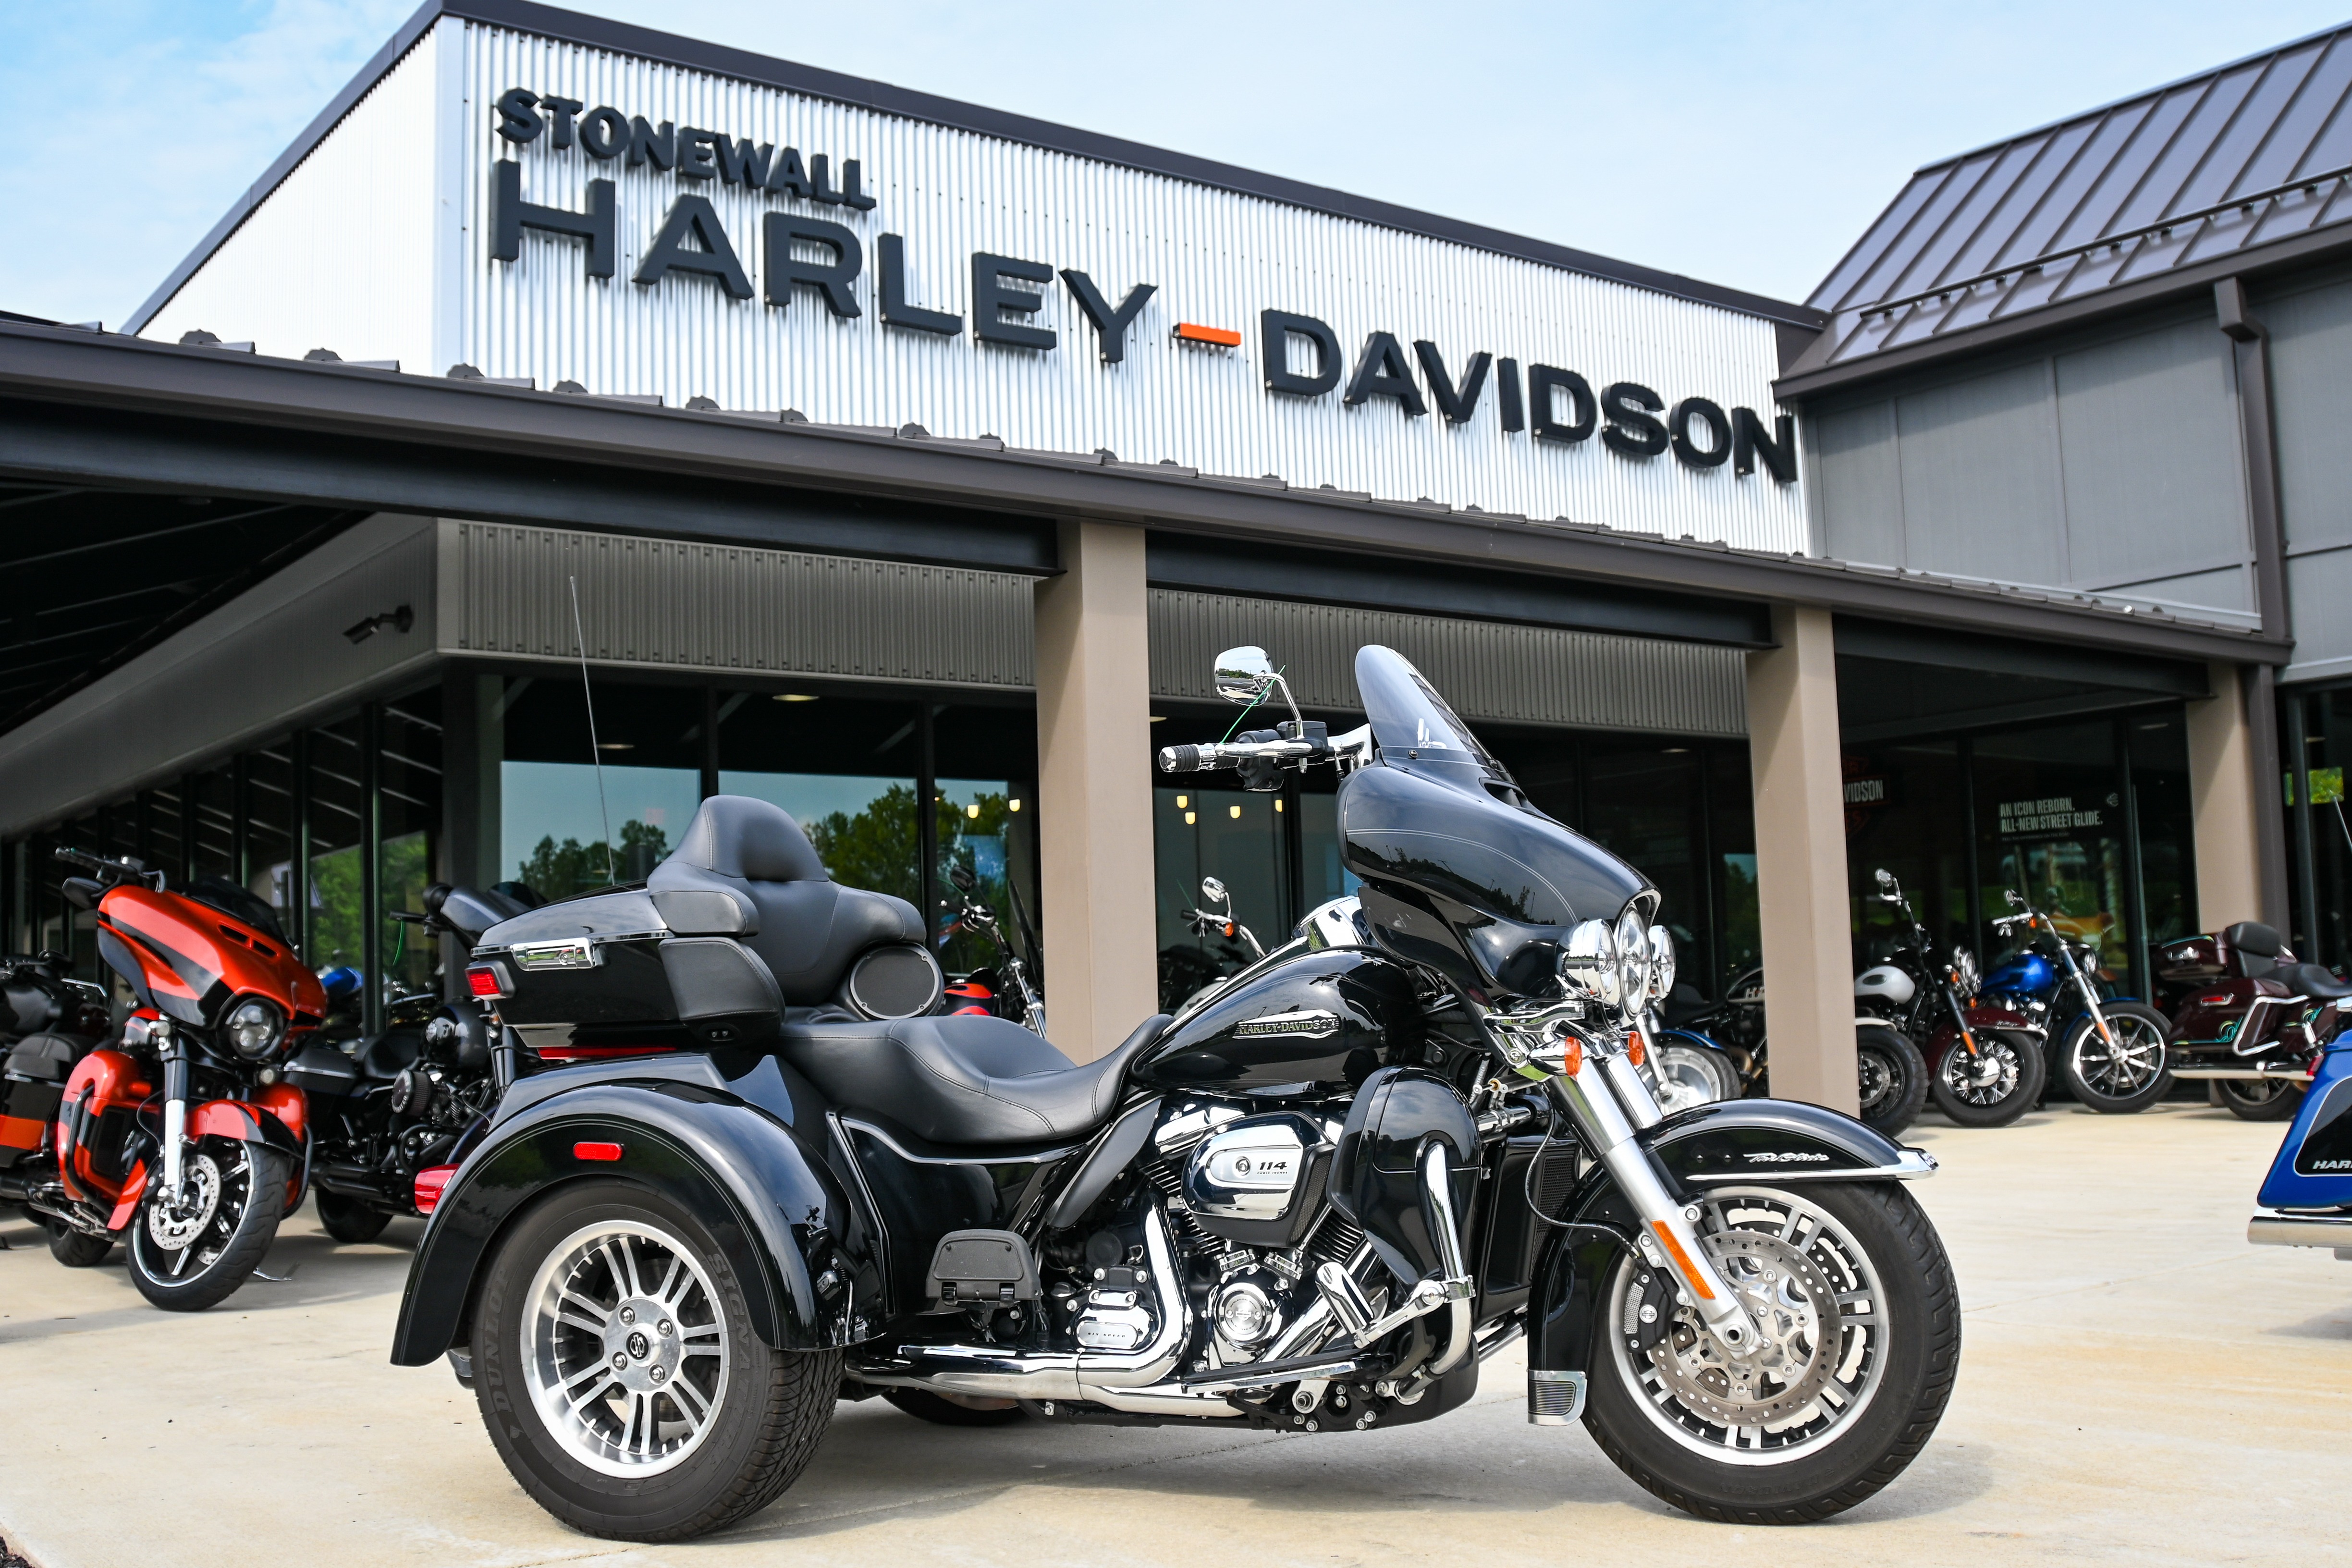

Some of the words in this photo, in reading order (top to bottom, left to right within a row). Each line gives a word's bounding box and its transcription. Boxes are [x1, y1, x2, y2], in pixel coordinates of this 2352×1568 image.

[494, 87, 877, 211] STONEWALL
[2000, 803, 2012, 817] AN
[2014, 801, 2035, 816] ICON
[2037, 797, 2075, 813] REBORN.
[2001, 816, 2039, 833] ALL-NEW
[2040, 813, 2072, 830] STREET
[2074, 810, 2103, 827] GLIDE.
[1239, 1018, 1336, 1034] HARLEY-DAVIDSON
[1259, 1162, 1287, 1170] 114
[2313, 1160, 2352, 1169] HAR
[484, 1269, 512, 1413] DUNLOP
[707, 1253, 751, 1473] SIGNATURE
